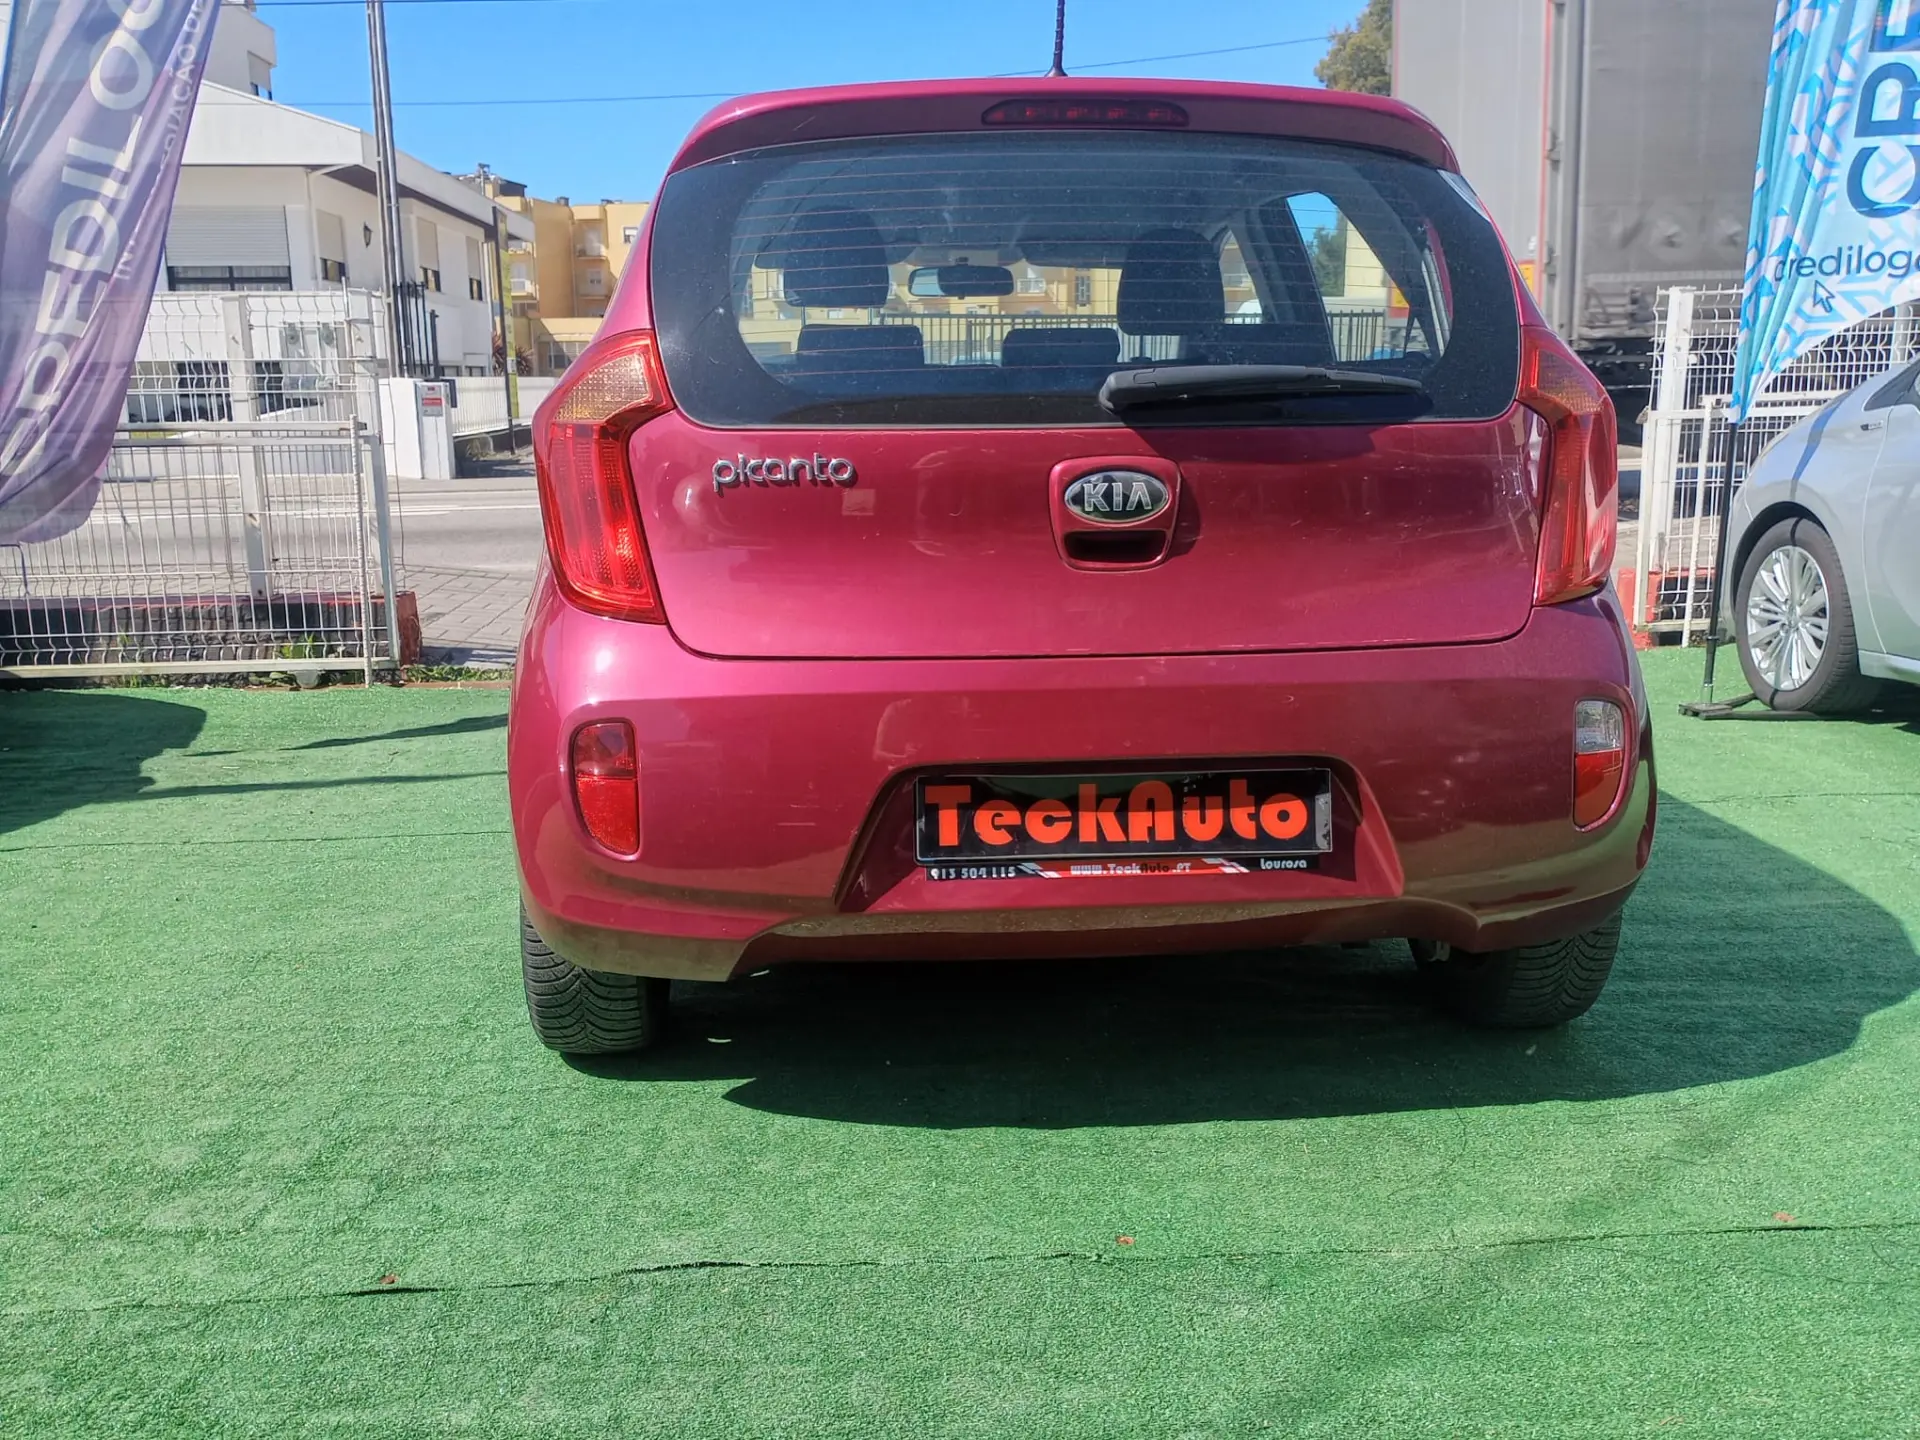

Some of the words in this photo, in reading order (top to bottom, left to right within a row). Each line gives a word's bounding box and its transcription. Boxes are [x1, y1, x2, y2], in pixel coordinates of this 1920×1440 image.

[1774, 244, 1920, 282] credilog
[712, 452, 853, 492] picanto
[1083, 482, 1152, 511] KIA
[925, 779, 1308, 847] TeckAuto
[930, 868, 956, 880] 913
[961, 867, 987, 879] 504
[992, 866, 1016, 878] 115
[1260, 858, 1308, 870] Lourosa
